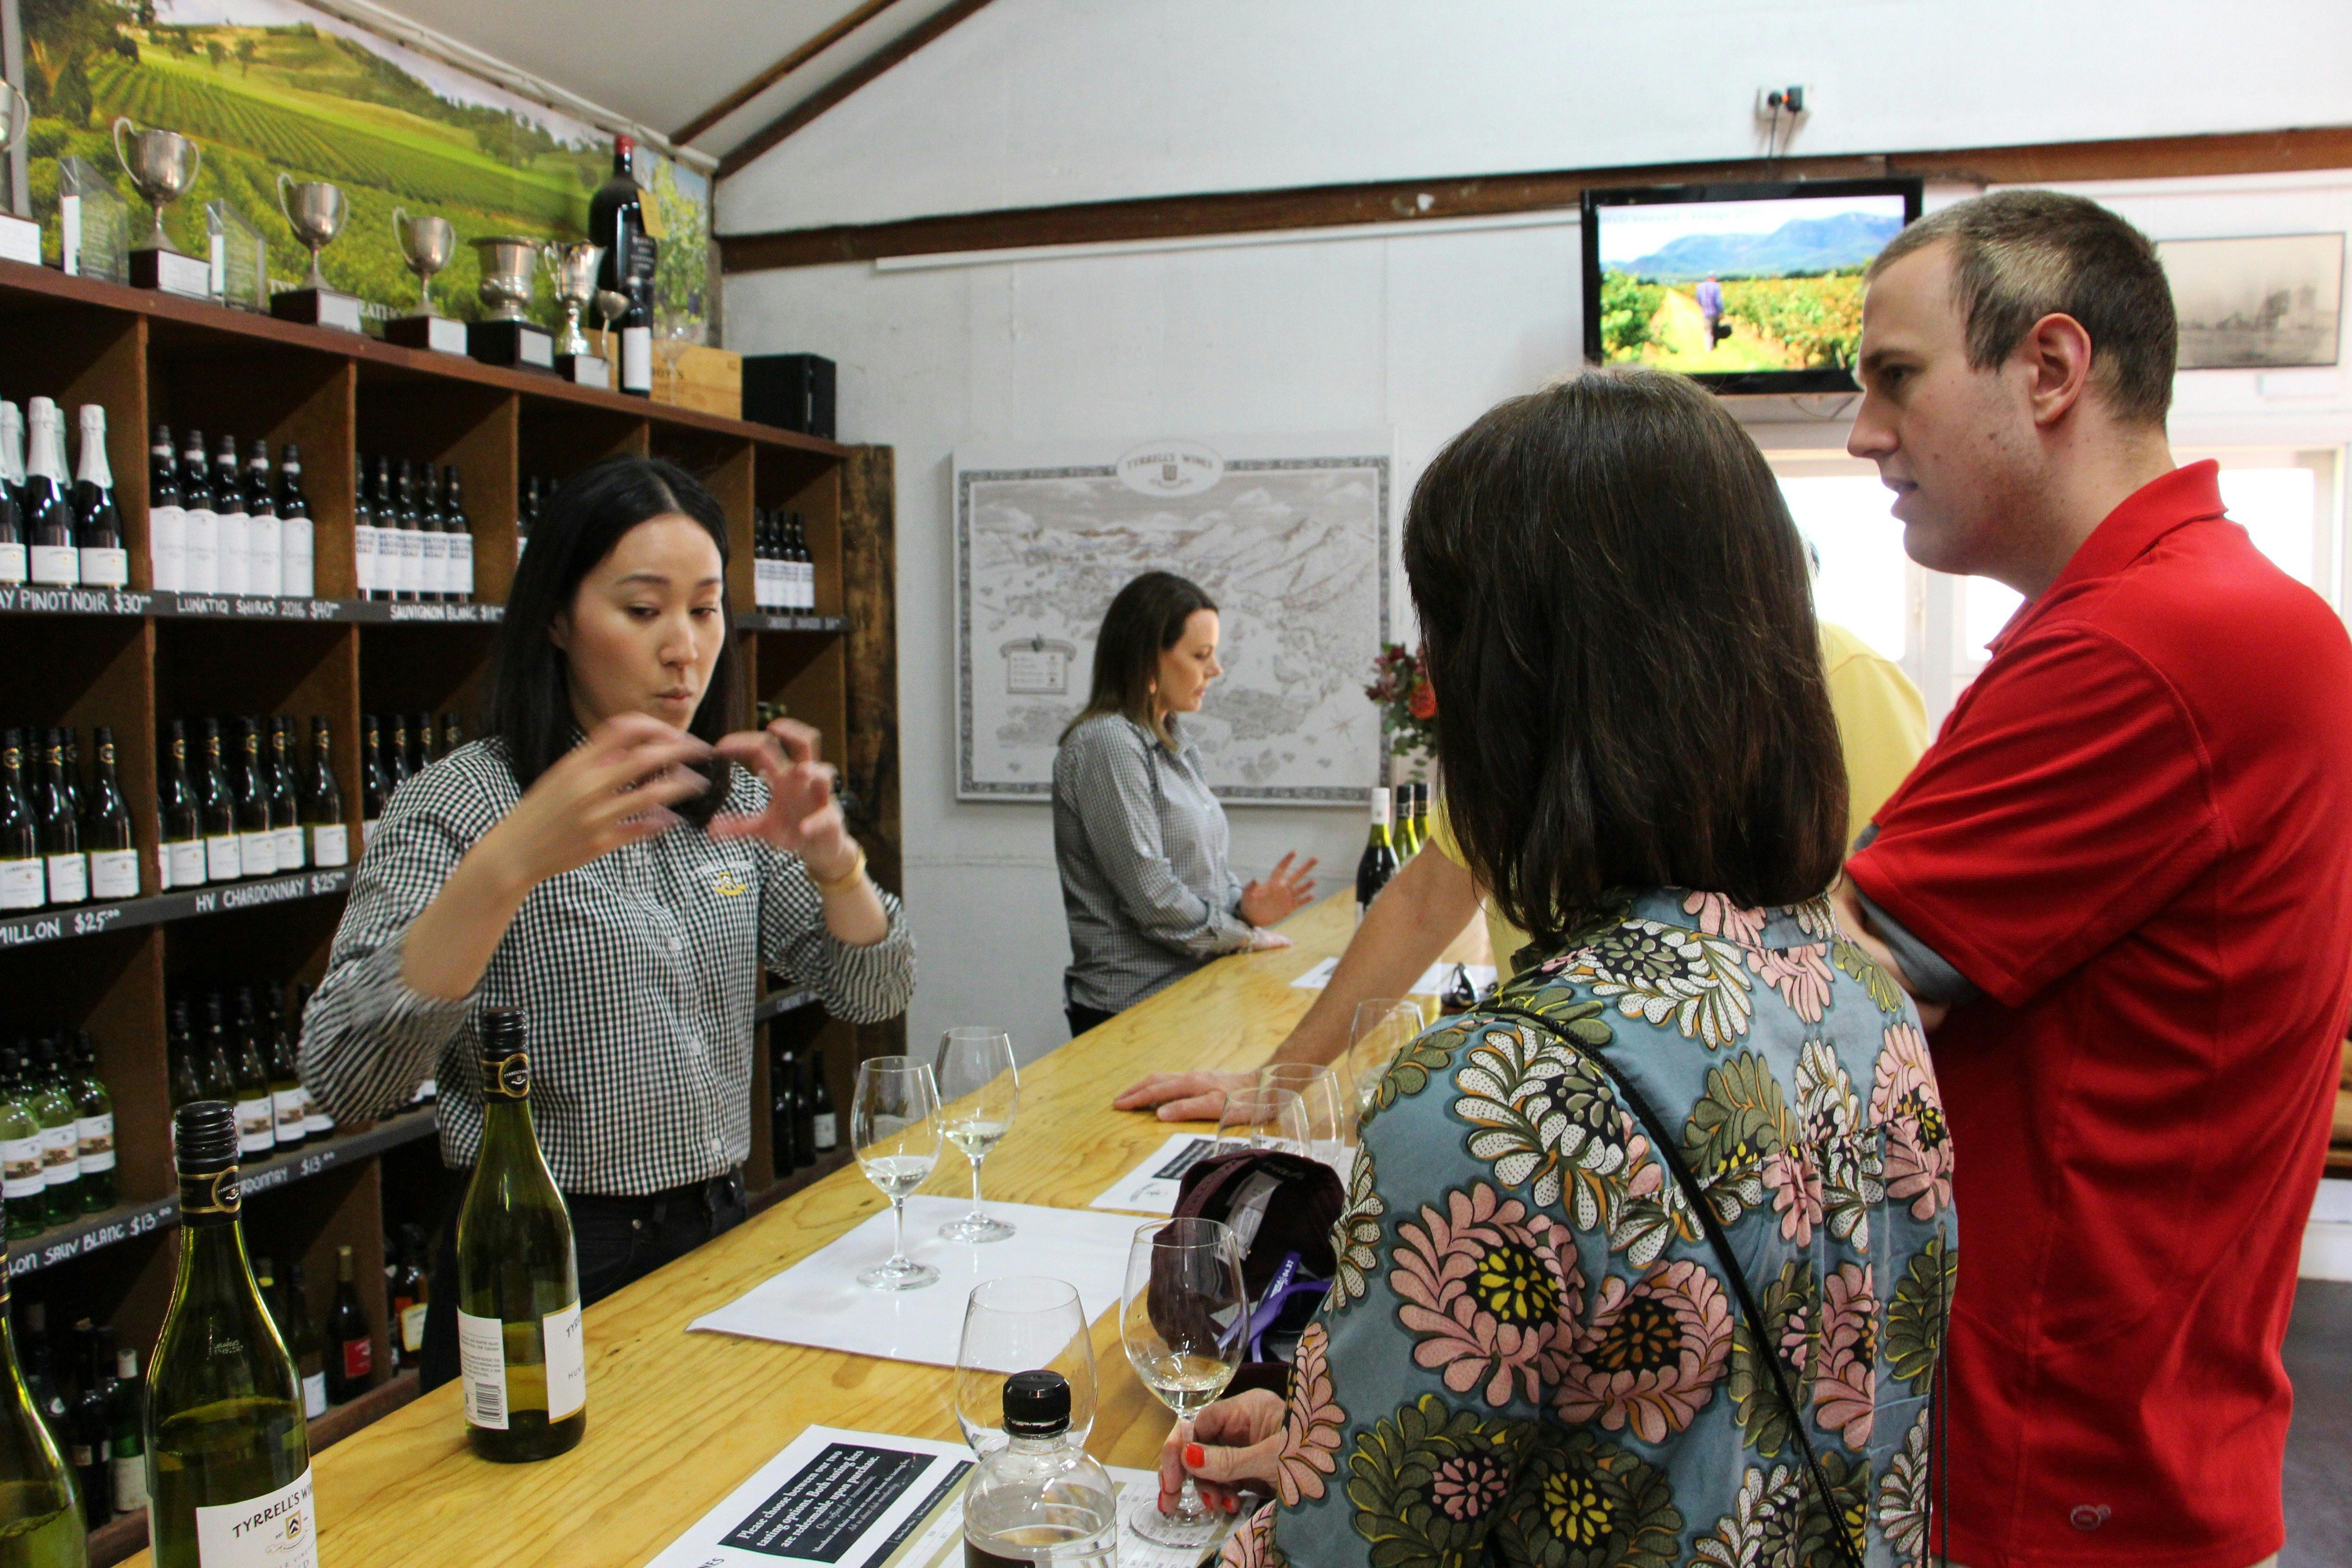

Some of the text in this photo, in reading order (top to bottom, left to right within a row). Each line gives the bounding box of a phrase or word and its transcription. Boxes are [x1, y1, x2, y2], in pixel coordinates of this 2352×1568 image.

[20, 589, 69, 612] PINOT
[70, 590, 110, 613] NOIR
[176, 597, 230, 615] LUNATIQ
[196, 892, 216, 913] HV
[222, 877, 306, 908] CHARDONNAY
[44, 1238, 80, 1266] SAUV
[83, 1224, 126, 1253] BLANC
[232, 1492, 300, 1539] TYRRELL'S
[736, 1450, 843, 1539] Please choose between our two
[756, 1450, 864, 1548] tasting options. Both tasting fees
[780, 1455, 881, 1548] are redeemable upon purchase.
